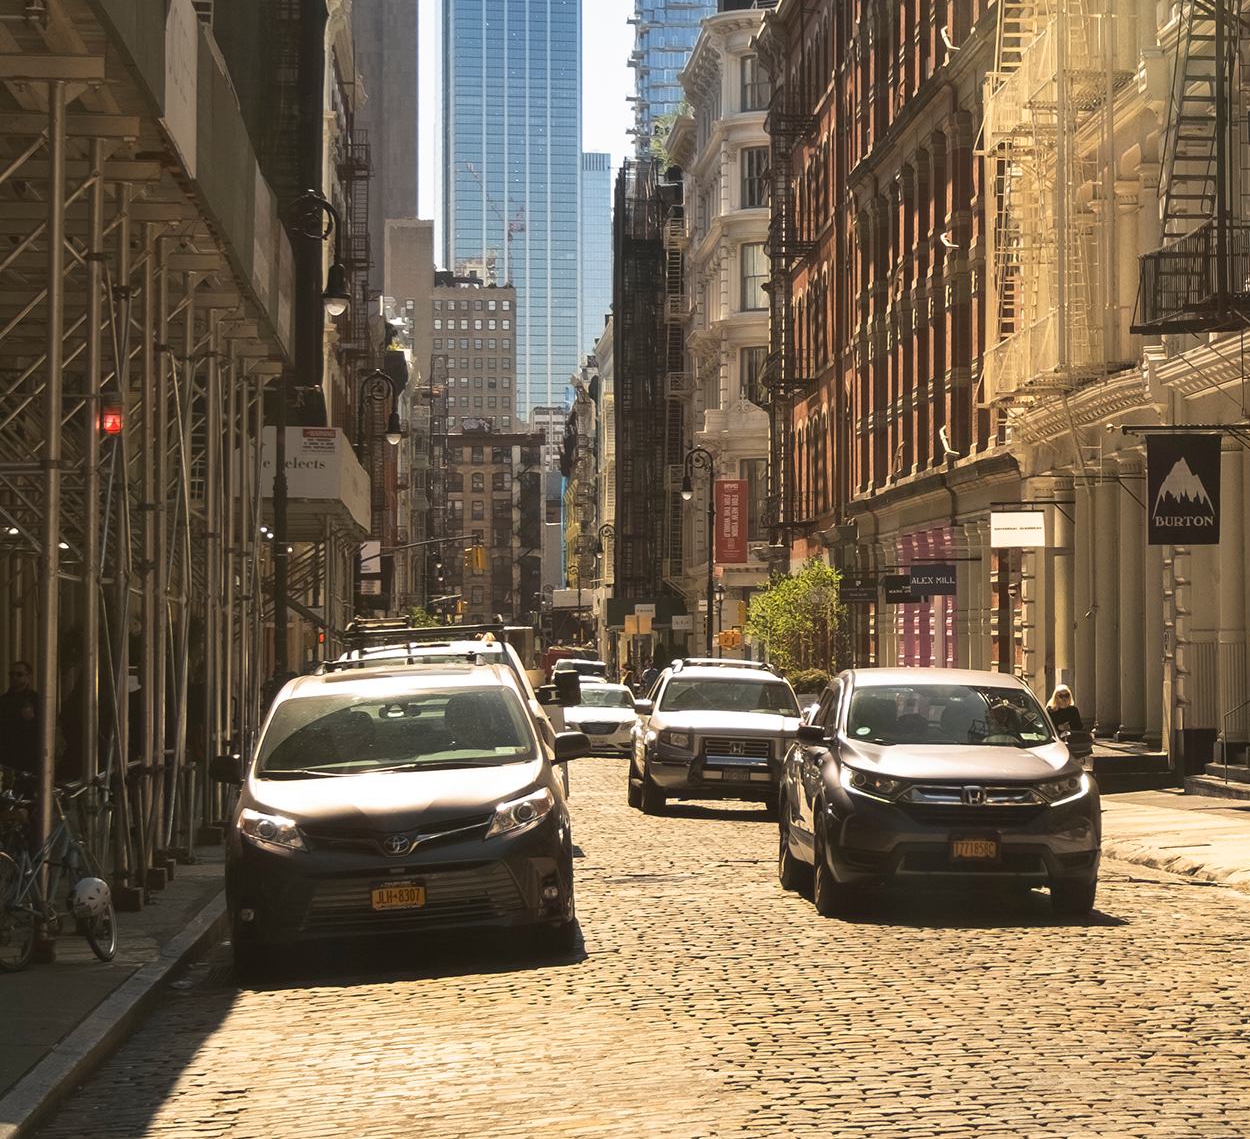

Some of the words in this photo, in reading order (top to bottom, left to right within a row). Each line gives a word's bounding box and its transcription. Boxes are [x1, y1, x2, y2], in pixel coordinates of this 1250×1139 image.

[285, 457, 326, 470] elects
[723, 494, 731, 506] FOR
[731, 494, 739, 506] FOR
[1155, 515, 1215, 527] BURTON
[911, 576, 934, 585] ALEX
[935, 576, 956, 585] MILL
